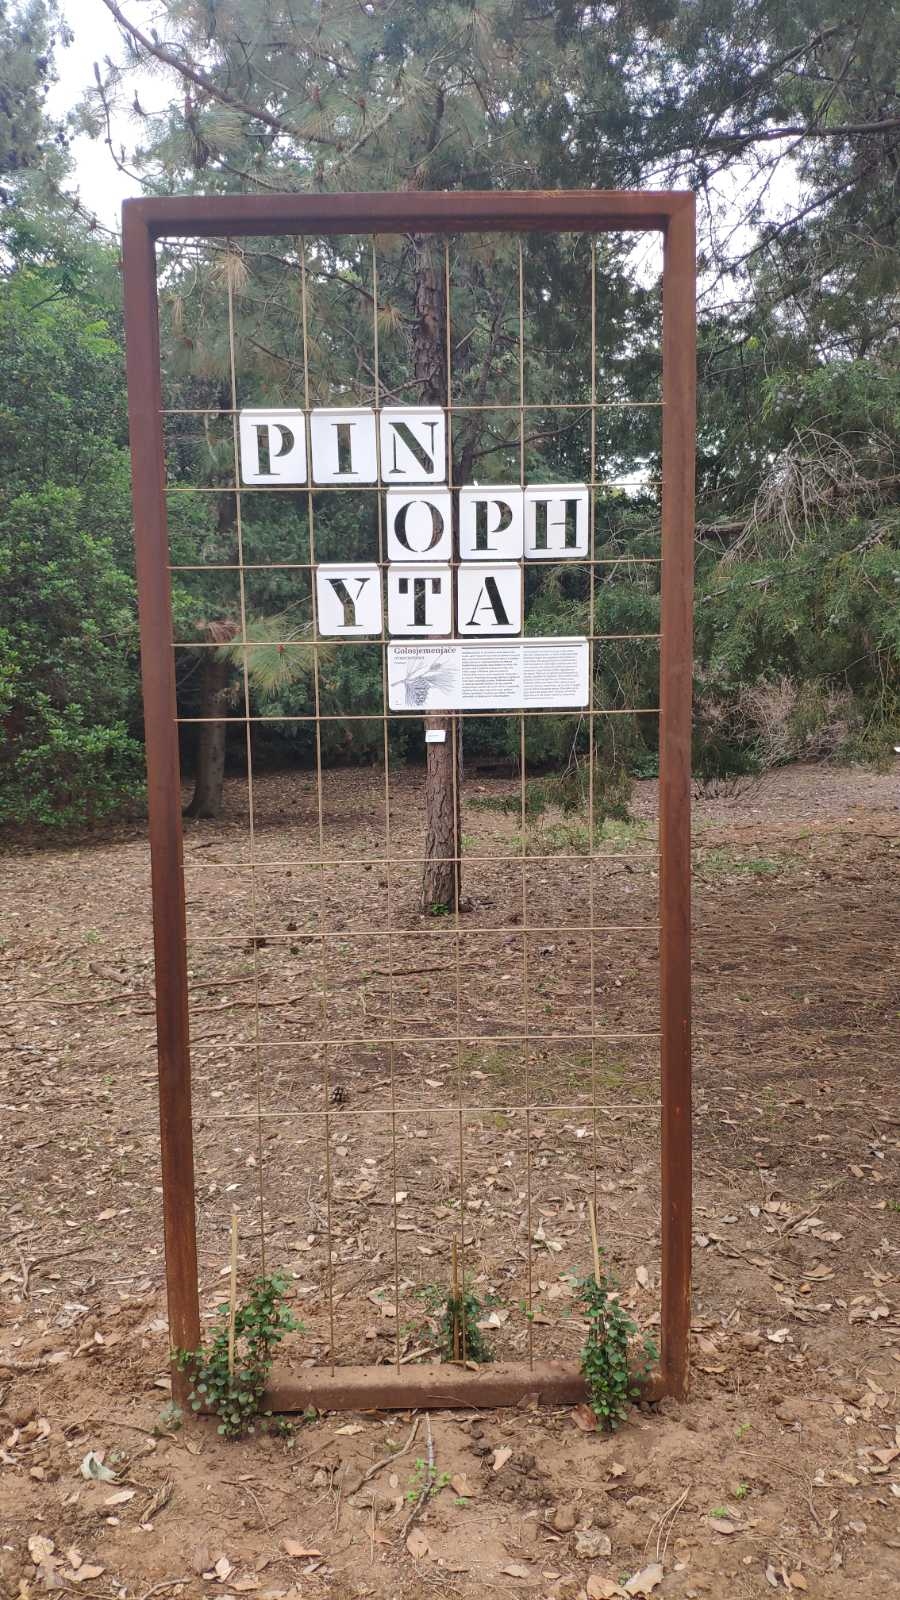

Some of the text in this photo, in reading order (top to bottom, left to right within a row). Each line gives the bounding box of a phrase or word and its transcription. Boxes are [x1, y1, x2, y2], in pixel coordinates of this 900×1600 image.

[251, 421, 440, 475] PIN
[393, 498, 582, 552] OPH
[325, 576, 514, 627] YTA
